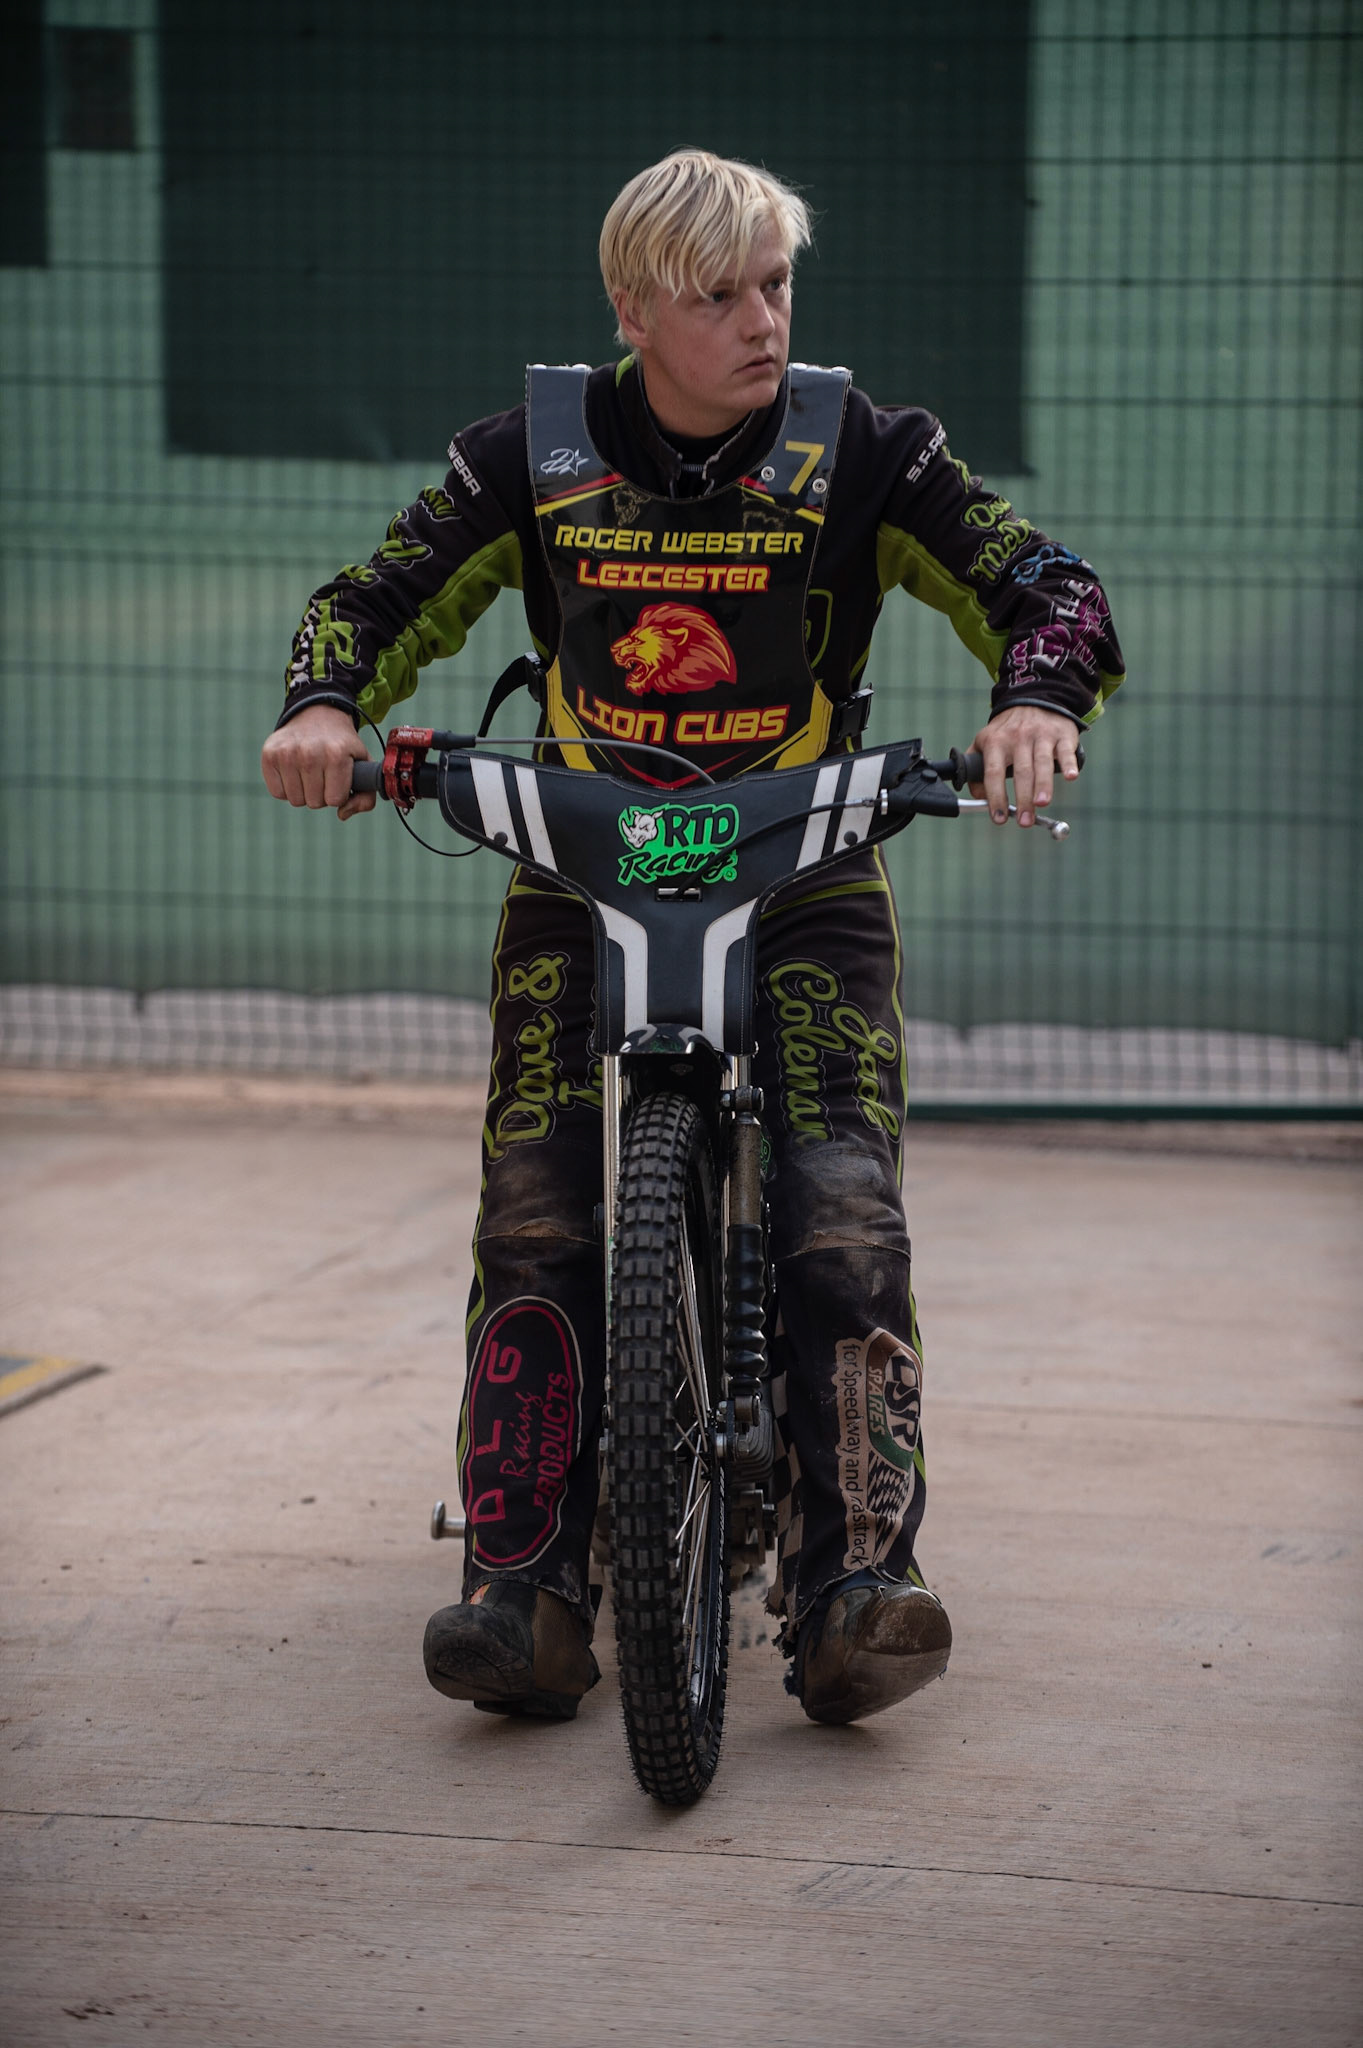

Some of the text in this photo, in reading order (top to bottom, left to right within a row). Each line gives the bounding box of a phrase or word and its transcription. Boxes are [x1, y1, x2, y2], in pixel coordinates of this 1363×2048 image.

[784, 440, 825, 496] 7
[555, 525, 804, 555] ROGER WEBSTER
[577, 558, 771, 592] LEICESTER
[576, 686, 791, 745] LION CUBS
[663, 806, 736, 848] RTD
[619, 849, 732, 882] Racing
[487, 956, 564, 1159] Dave &
[769, 962, 846, 1142] Coleman
[842, 1343, 862, 1368] for
[841, 1369, 865, 1456] Speedway
[868, 1366, 886, 1437] SPARES
[500, 1391, 543, 1479] Racing
[533, 1372, 570, 1511] PRODUCTS
[845, 1458, 864, 1492] and
